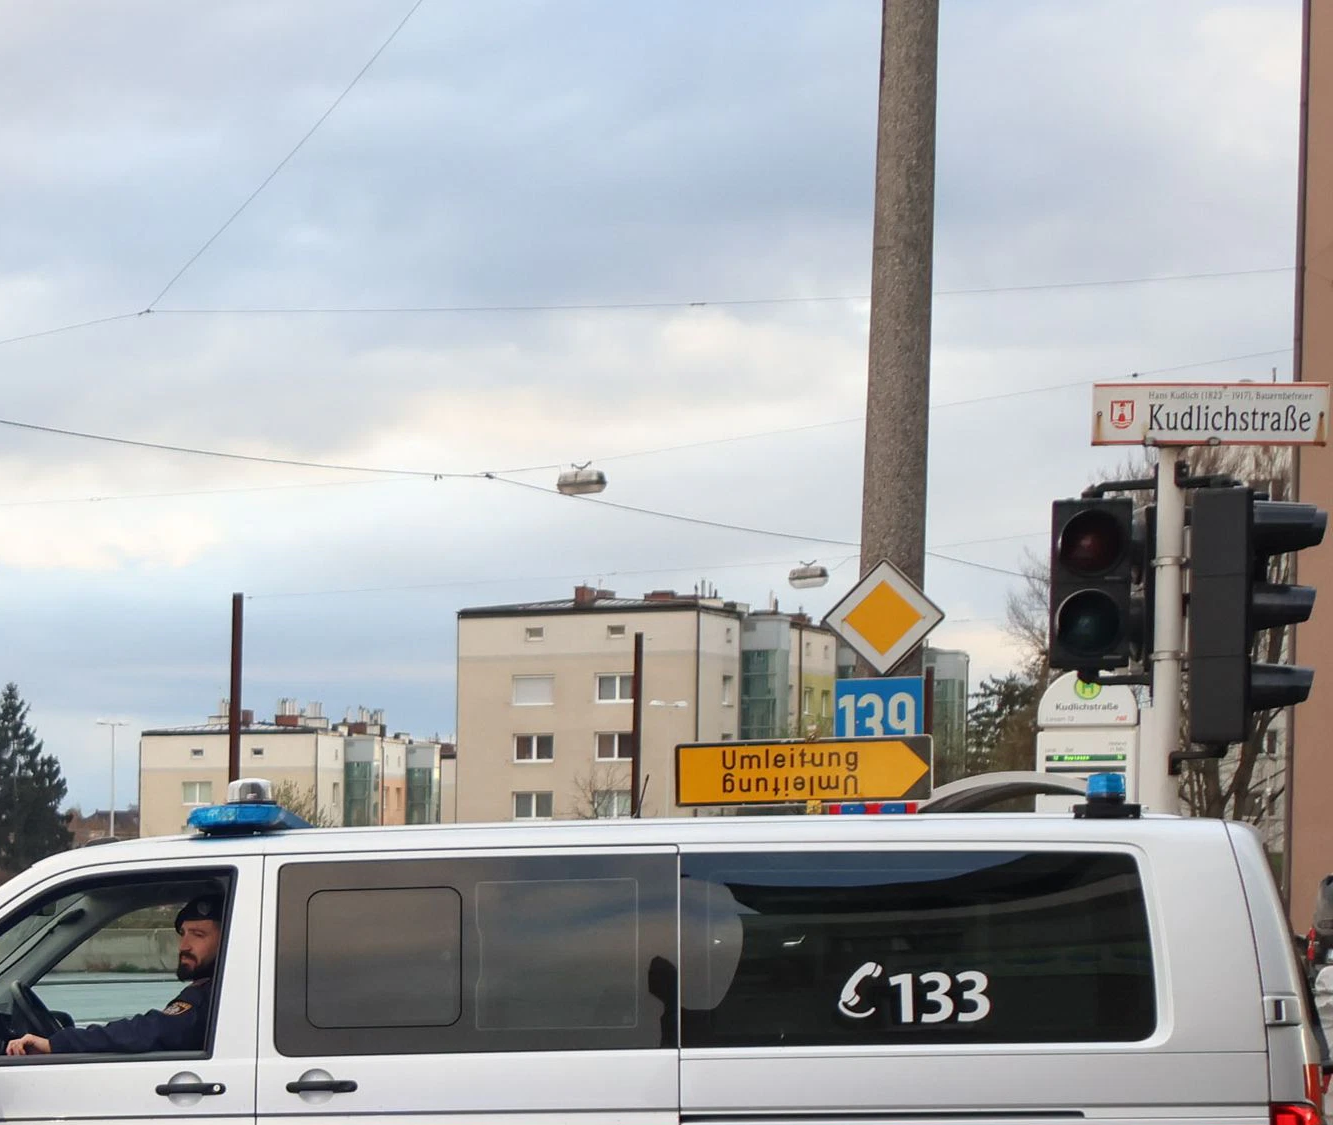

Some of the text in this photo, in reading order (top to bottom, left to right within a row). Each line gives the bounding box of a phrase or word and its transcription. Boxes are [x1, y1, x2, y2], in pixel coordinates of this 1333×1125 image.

[1148, 391, 1168, 400] Hans
[1170, 391, 1199, 400] Kudlich
[1148, 403, 1312, 432] Kudlichstraße
[837, 691, 917, 736] 139
[1055, 702, 1119, 711] Kudlichstraße
[721, 748, 859, 773] Umleitung
[721, 773, 859, 796] Umleitung
[887, 970, 992, 1025] 133
